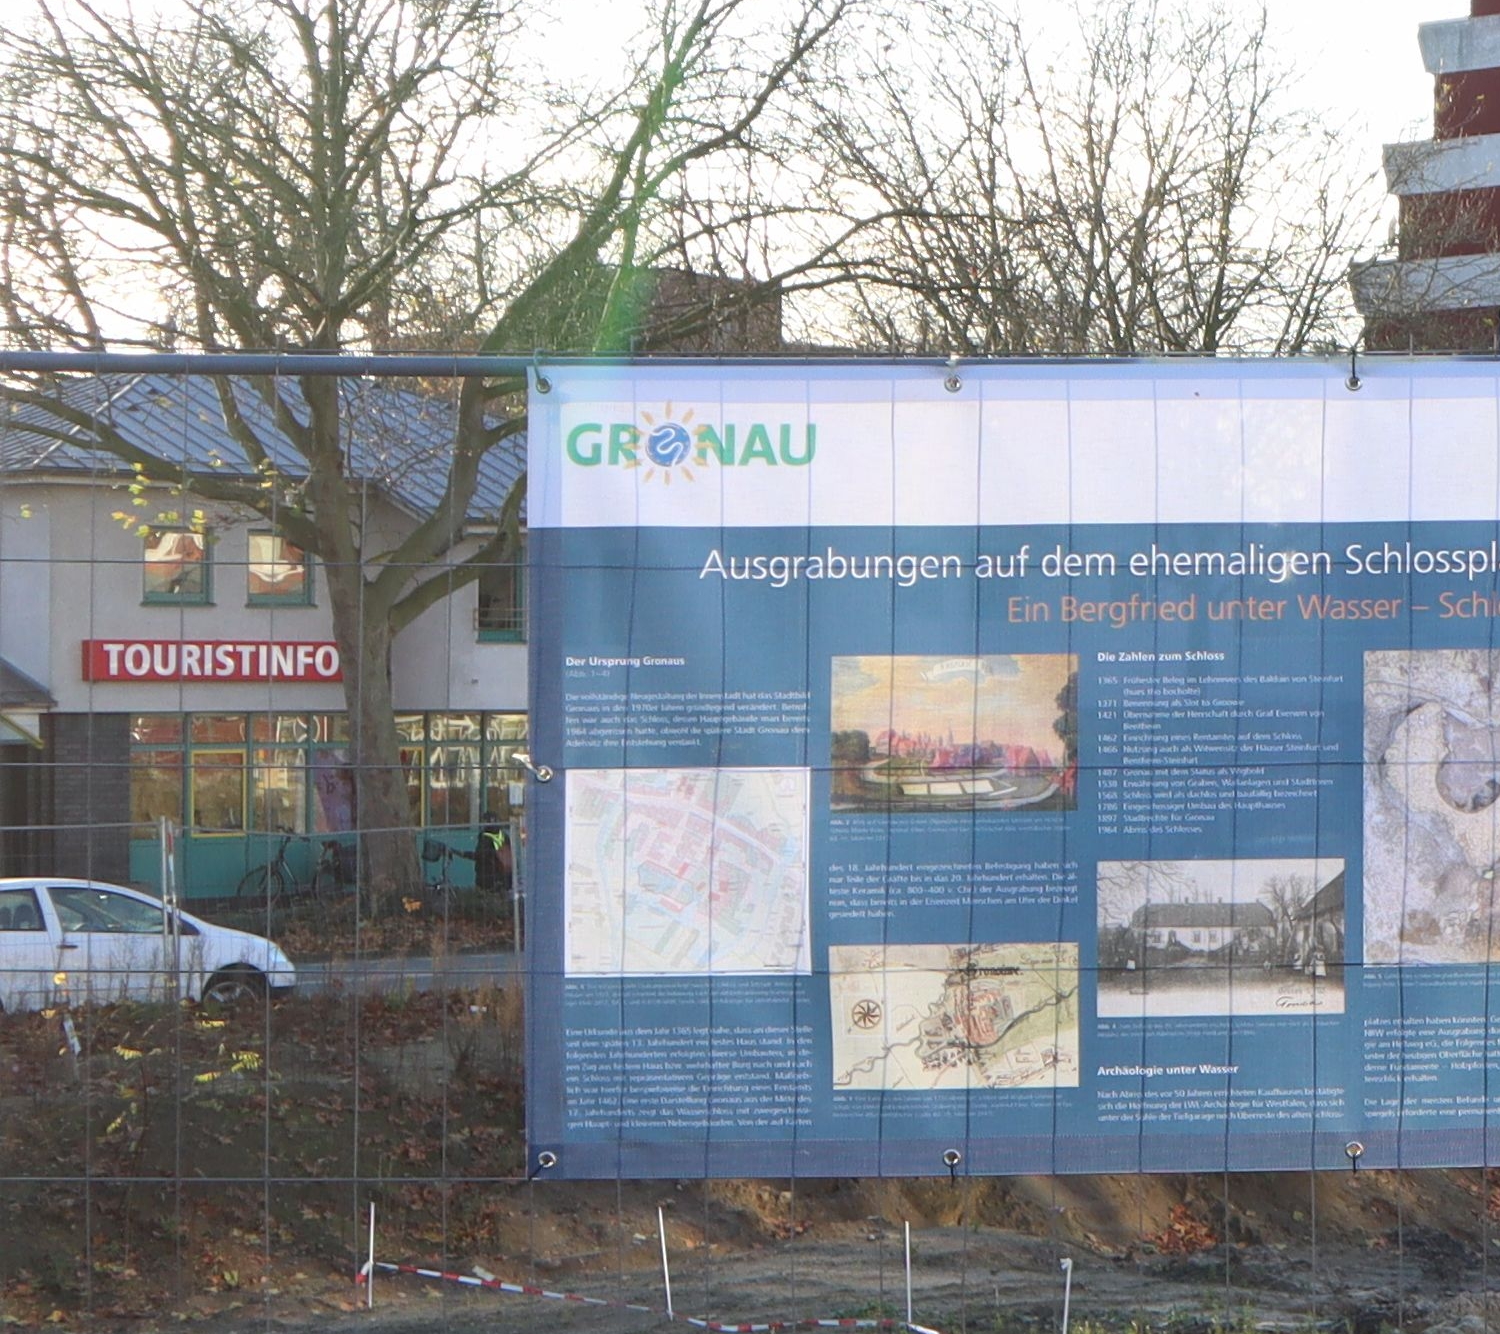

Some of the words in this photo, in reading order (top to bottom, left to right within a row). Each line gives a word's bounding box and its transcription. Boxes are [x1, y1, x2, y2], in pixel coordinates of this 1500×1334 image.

[700, 548, 961, 587] Ausgrabungen
[975, 546, 1029, 578] auf
[1041, 545, 1114, 577] dem
[1129, 544, 1331, 583] ehemaligen
[1008, 597, 1049, 622] Ein
[1061, 594, 1197, 628] Bergfried
[1208, 597, 1286, 620] unter
[1298, 595, 1401, 619] Wasser
[103, 643, 339, 677] TOURISTINFO
[566, 657, 585, 666] Der
[589, 657, 640, 667] Ursprung
[643, 657, 685, 666] Gronaus
[1098, 652, 1115, 661] Die
[1119, 652, 1155, 661] Zahlen
[1159, 653, 1181, 661] zum
[1185, 652, 1224, 661] Schloss
[1098, 1066, 1163, 1077] Archäologie
[1167, 1066, 1195, 1074] unter
[1200, 1065, 1239, 1074] Wasser
